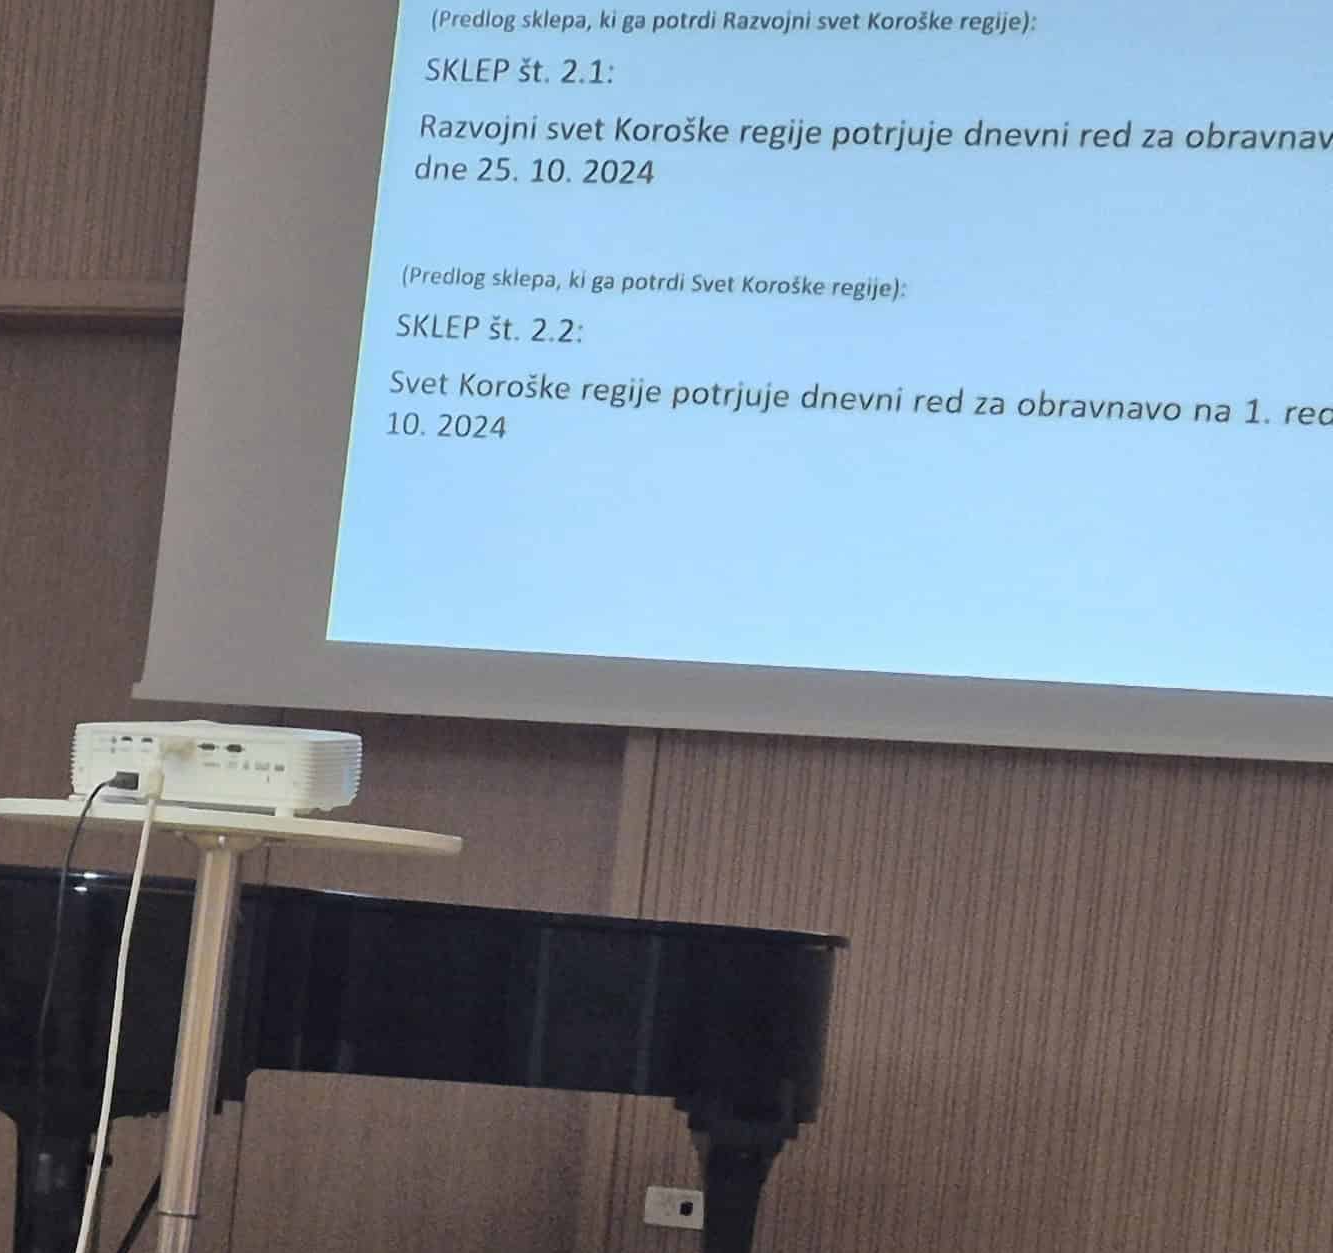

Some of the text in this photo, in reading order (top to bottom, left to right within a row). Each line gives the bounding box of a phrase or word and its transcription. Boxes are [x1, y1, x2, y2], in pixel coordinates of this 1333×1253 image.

[431, 10, 1037, 35] (Predlog sklepa, ki ga potrdi Razvojni svet Koroške regije):
[425, 58, 614, 84] SKLEP št. 2.1:
[420, 114, 537, 141] Razvojni
[546, 118, 604, 141] svet
[615, 117, 729, 143] Koroške
[739, 120, 822, 150] regije
[833, 122, 952, 152] potrjuje
[964, 120, 1069, 148] dnevni
[1079, 121, 1132, 148] red
[1142, 128, 1173, 148] za
[414, 156, 655, 184] dne 25. 10. 2024
[402, 265, 906, 302] (Predlog sklepa, ki ga potrdi Svet Koroške regije):
[396, 313, 583, 343] SKLEP št. 2.2:
[390, 370, 448, 395] Svet
[459, 372, 571, 399] Koroške
[581, 379, 661, 408] regije
[672, 382, 790, 413] potrjuje
[801, 385, 902, 413] dnevni
[913, 388, 963, 414] red
[974, 395, 1005, 415] za
[1017, 390, 1181, 421] obravnavo
[1193, 402, 1231, 423] na
[1245, 399, 1269, 424] 1.
[386, 411, 507, 438] 10. 2024
